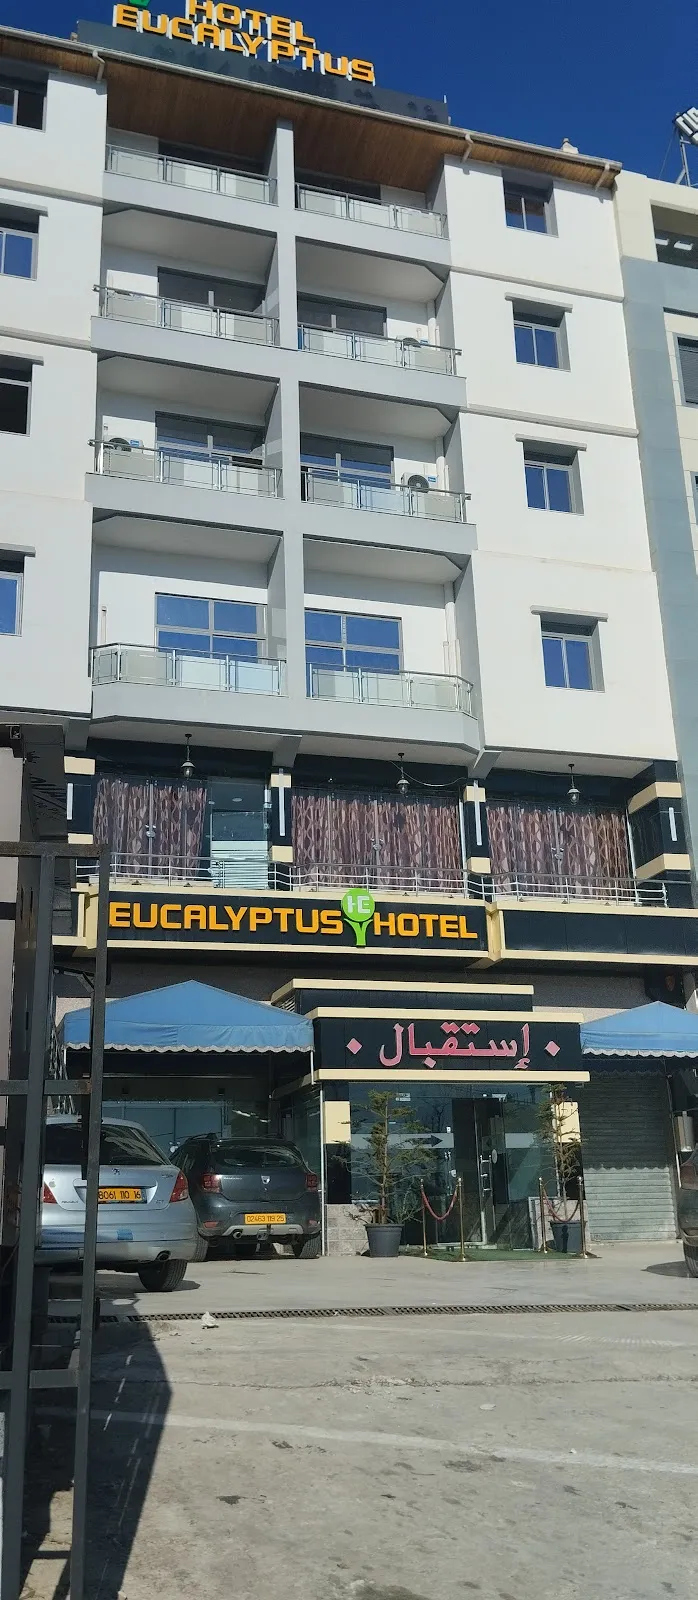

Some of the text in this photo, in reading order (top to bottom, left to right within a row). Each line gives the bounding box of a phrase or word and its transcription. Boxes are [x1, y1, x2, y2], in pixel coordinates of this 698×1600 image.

[113, 4, 375, 85] EUCALYPTUS
[186, 0, 315, 47] HOTEL
[108, 901, 478, 939] EUCALYPTUS HOTEL
[379, 1021, 531, 1069] إستقبال
